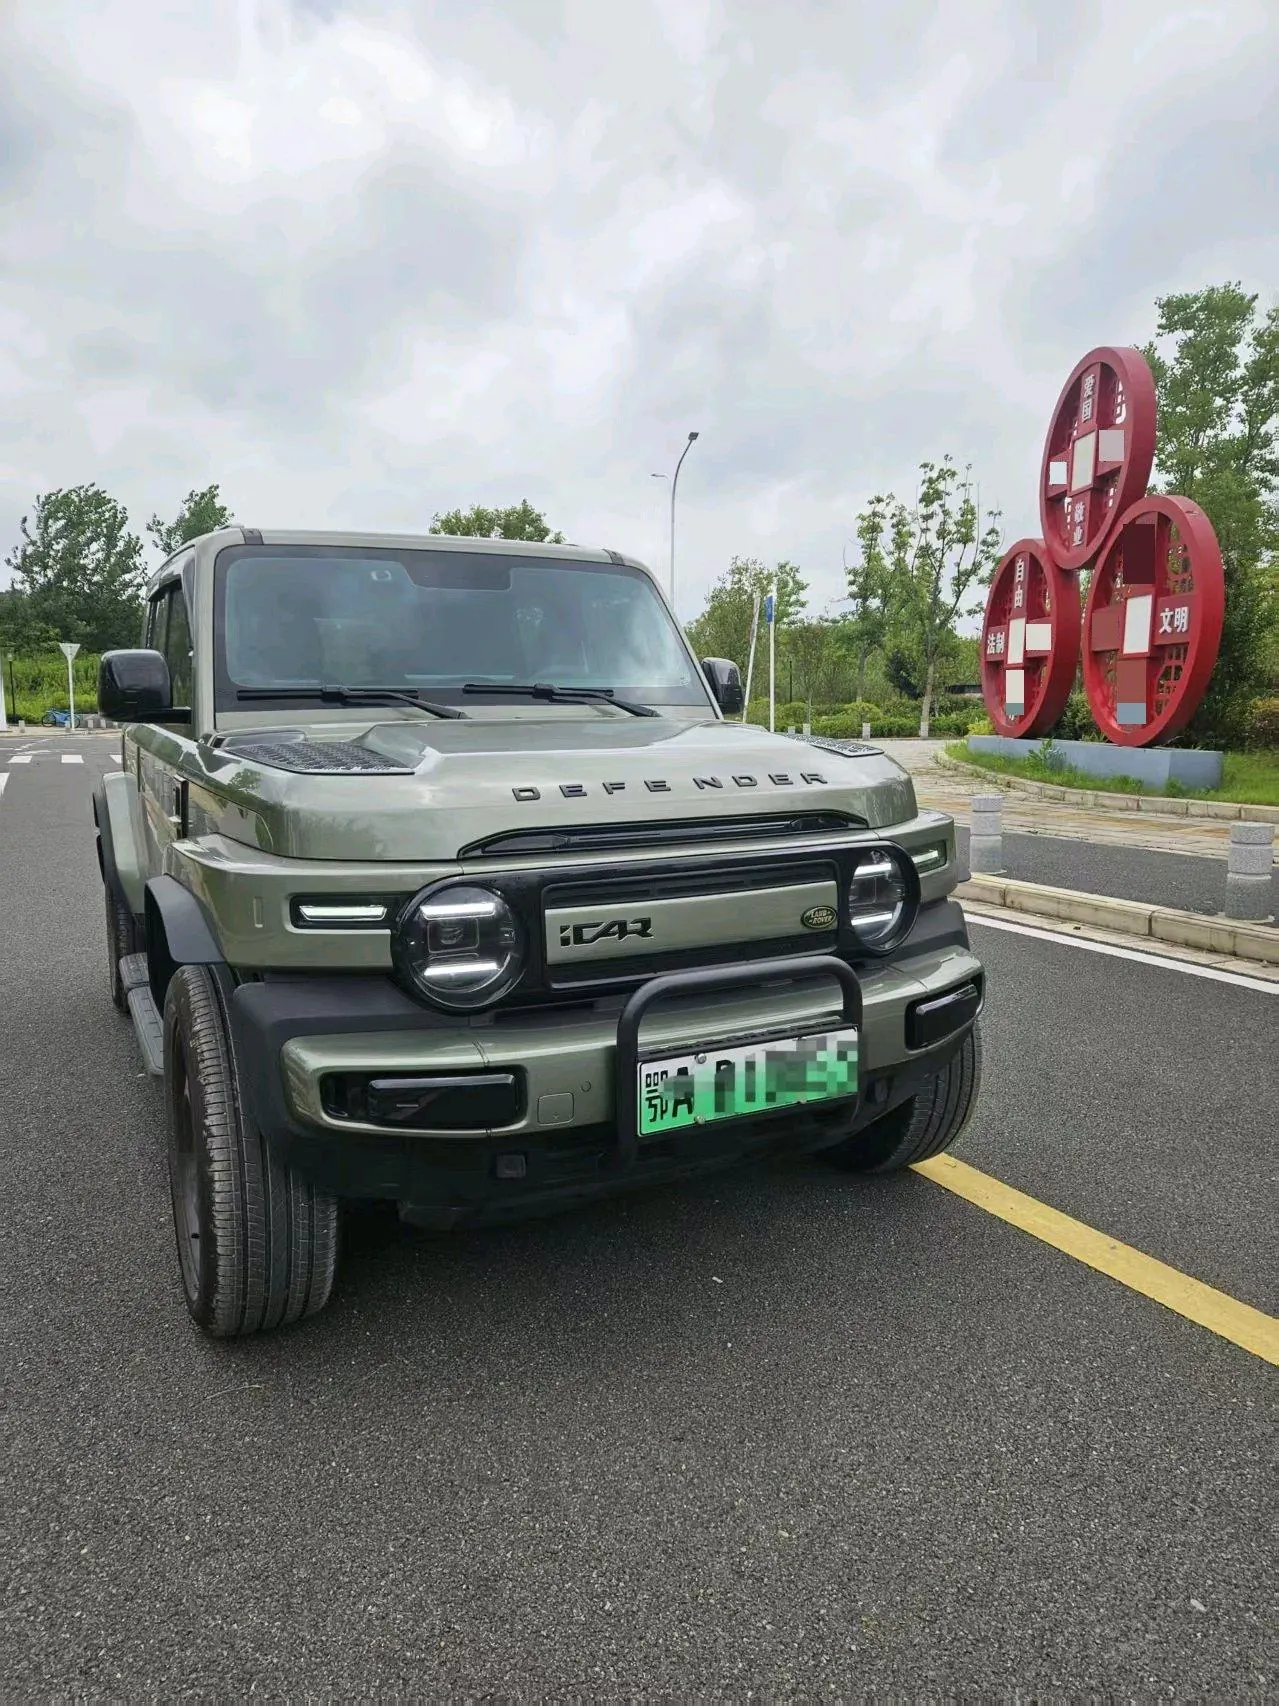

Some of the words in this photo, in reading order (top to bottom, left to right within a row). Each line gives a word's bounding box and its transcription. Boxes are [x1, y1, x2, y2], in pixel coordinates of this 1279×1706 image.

[1014, 559, 1025, 609] 自由
[1158, 606, 1189, 634] 文明
[512, 772, 828, 801] DEFENDER
